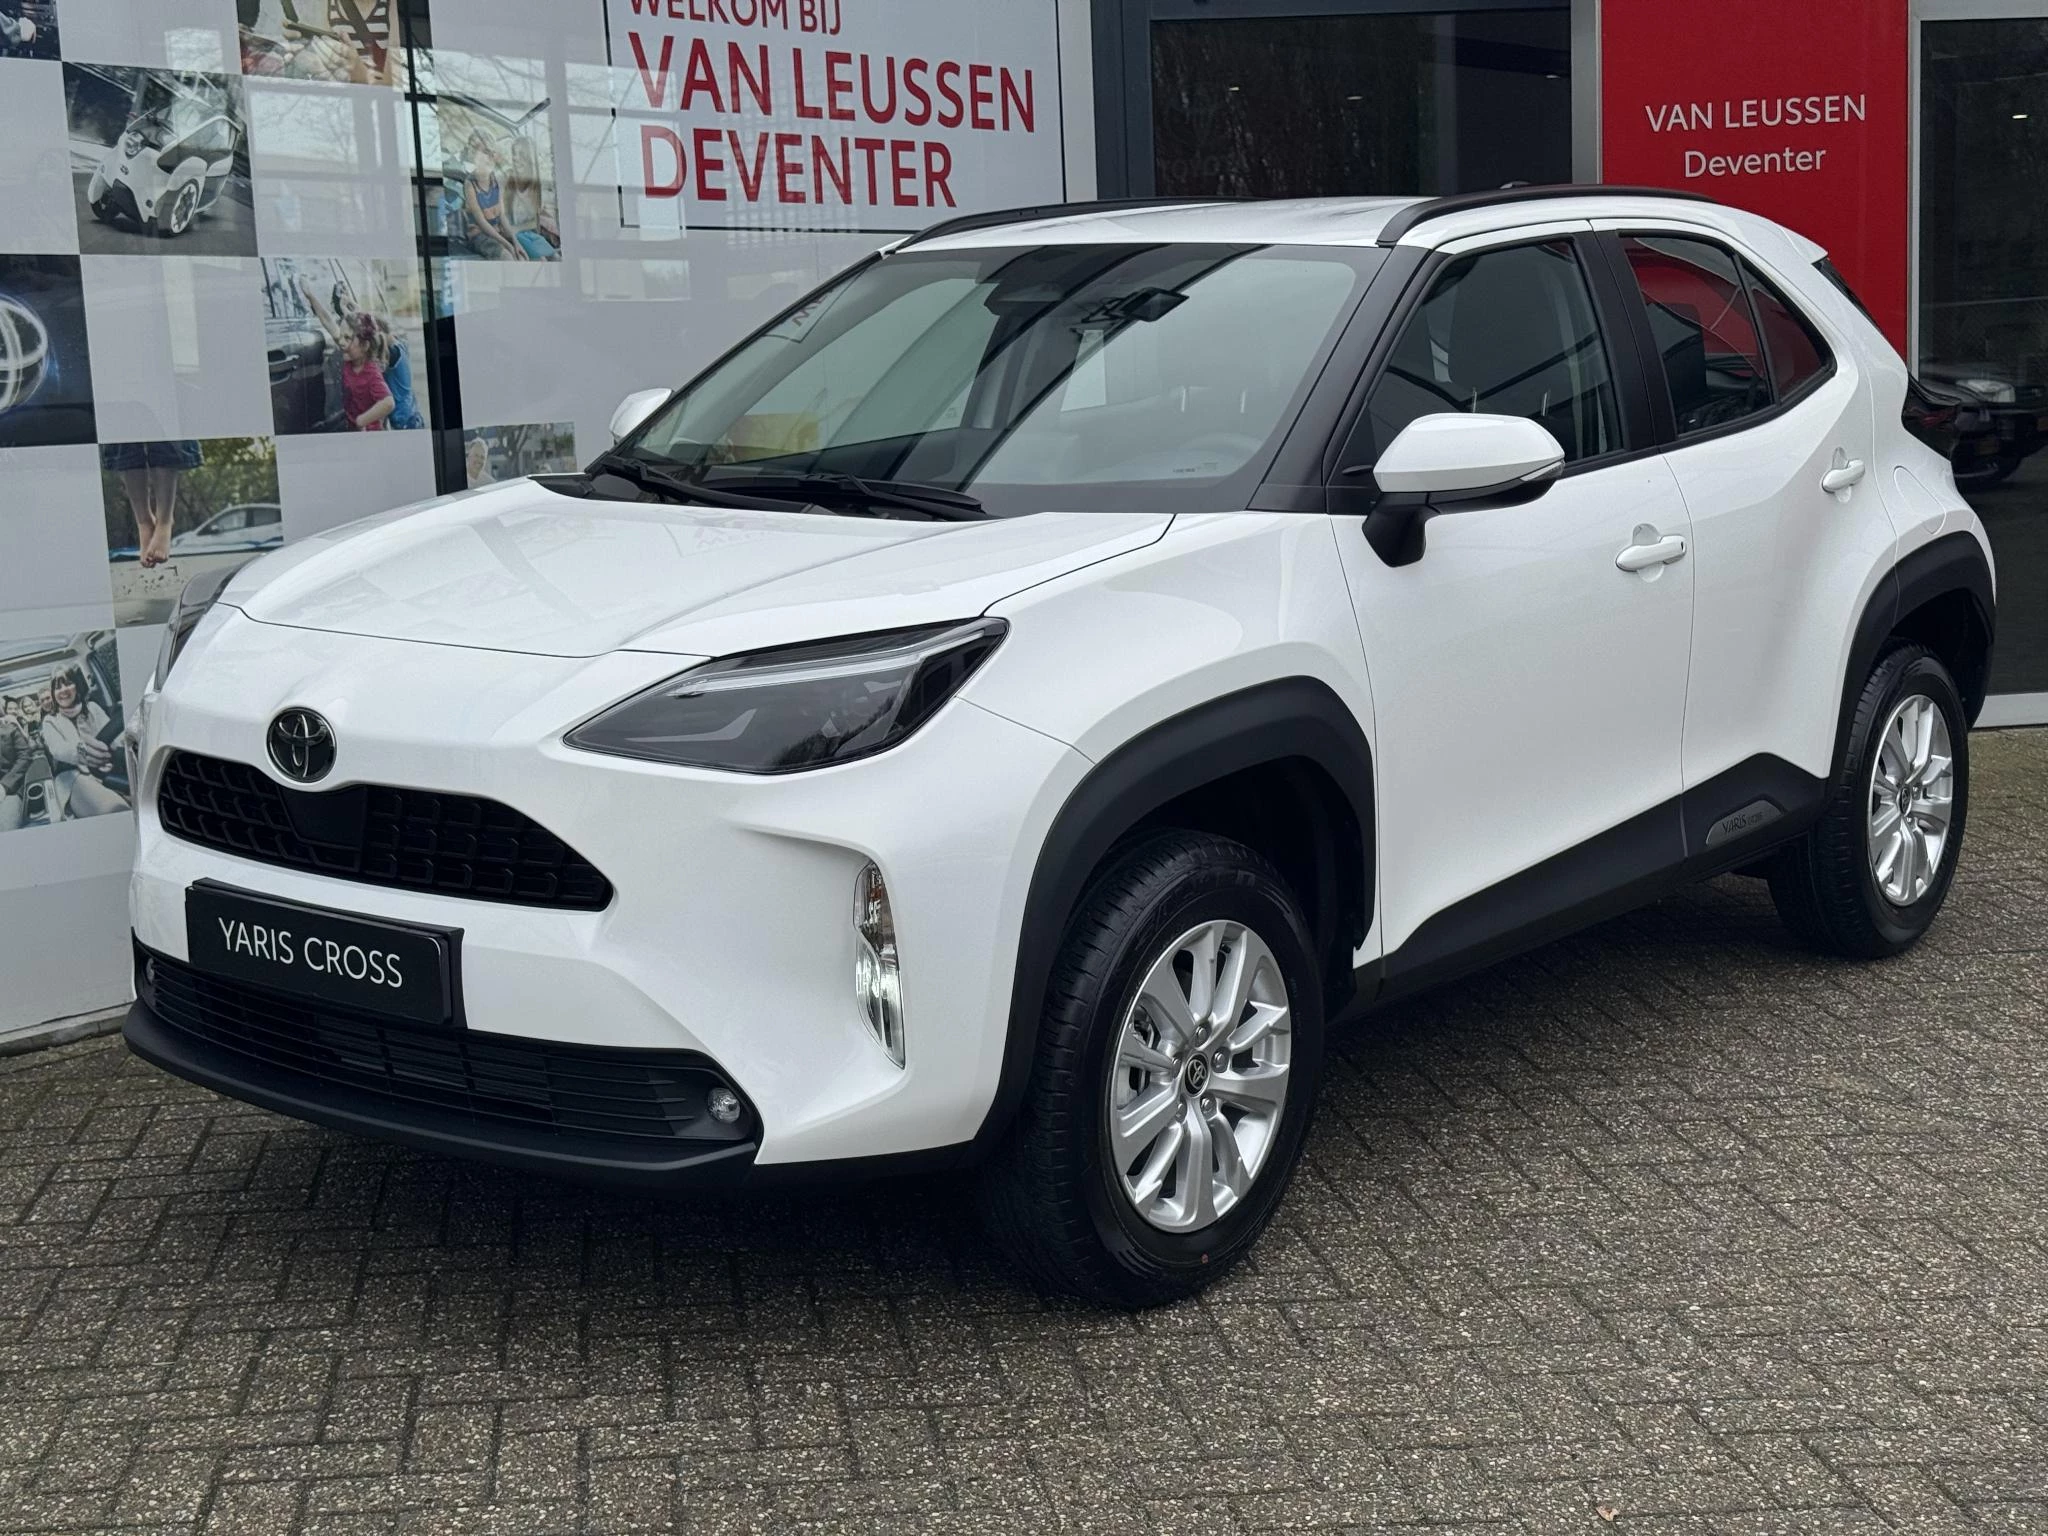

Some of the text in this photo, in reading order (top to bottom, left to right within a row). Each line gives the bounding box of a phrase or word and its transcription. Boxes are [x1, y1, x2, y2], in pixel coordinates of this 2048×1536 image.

[799, 0, 842, 36] BIJ
[628, 31, 1035, 134] VAN LEUSSEN
[1644, 94, 1866, 132] VAN LEUSSEN
[640, 124, 958, 208] DEVENTER
[1684, 147, 1827, 178] Deventer
[218, 917, 403, 988] YARIS CROSS
